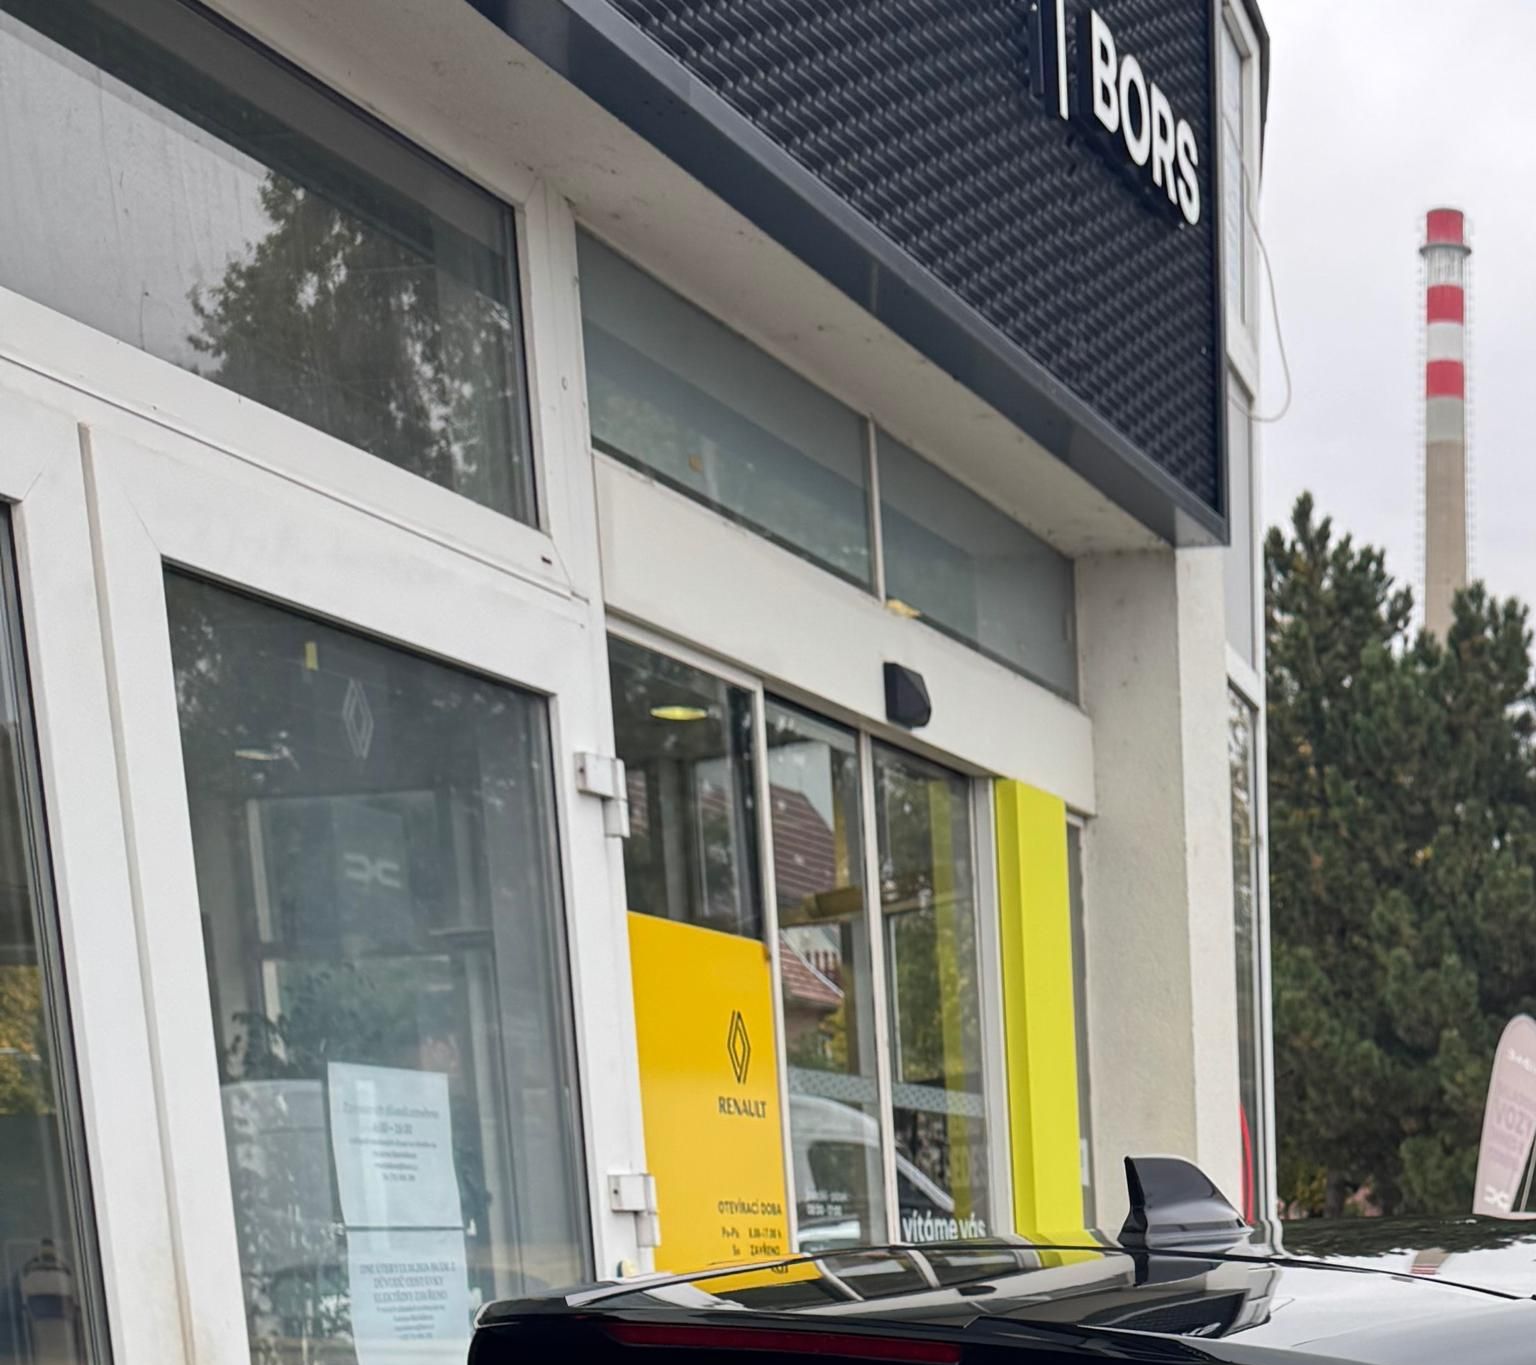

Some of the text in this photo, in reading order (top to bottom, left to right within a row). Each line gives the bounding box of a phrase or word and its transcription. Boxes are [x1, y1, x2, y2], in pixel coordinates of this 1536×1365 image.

[1090, 9, 1200, 225] BORS
[718, 1096, 767, 1119] RENAULT
[761, 1202, 782, 1216] DOBA
[903, 1210, 987, 1243] vítáme vás
